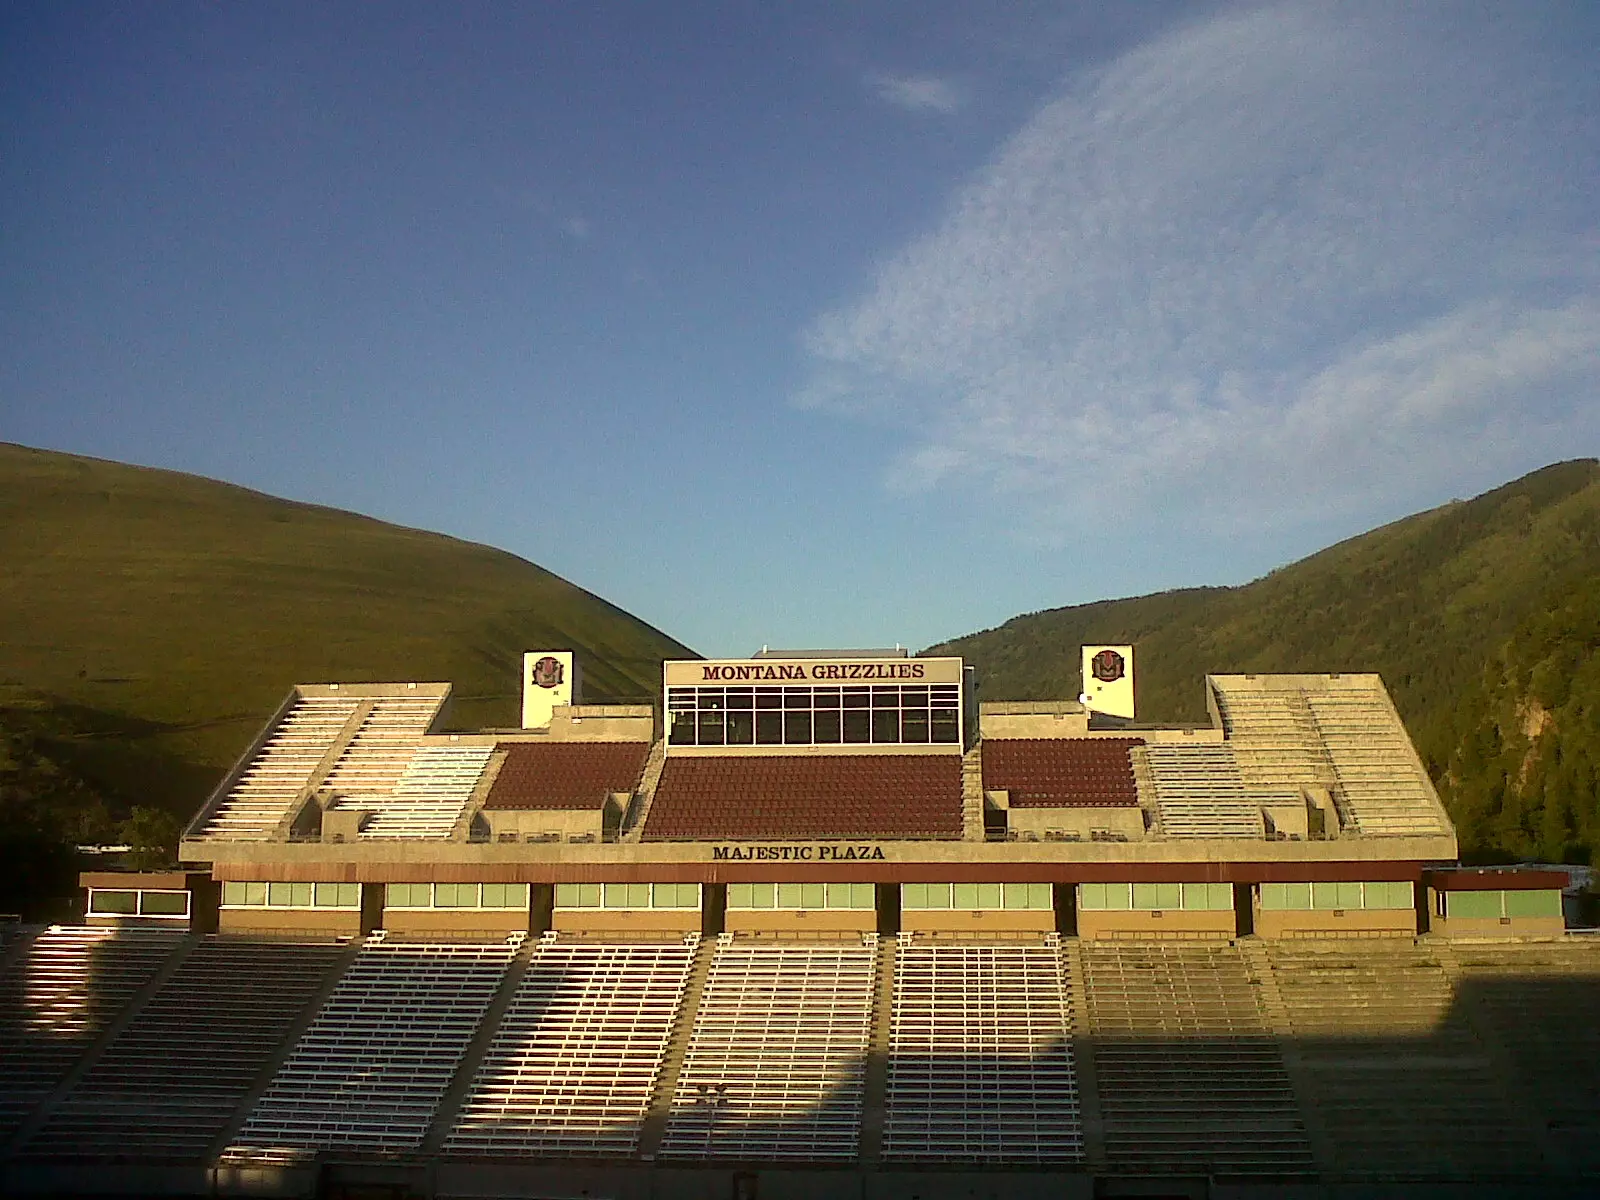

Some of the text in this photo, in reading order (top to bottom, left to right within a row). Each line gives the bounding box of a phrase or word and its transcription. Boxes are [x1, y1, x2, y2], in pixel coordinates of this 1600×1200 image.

[702, 664, 924, 680] MONTANA GRIZZLIES
[713, 846, 885, 860] MAJESTIC PLAZA
